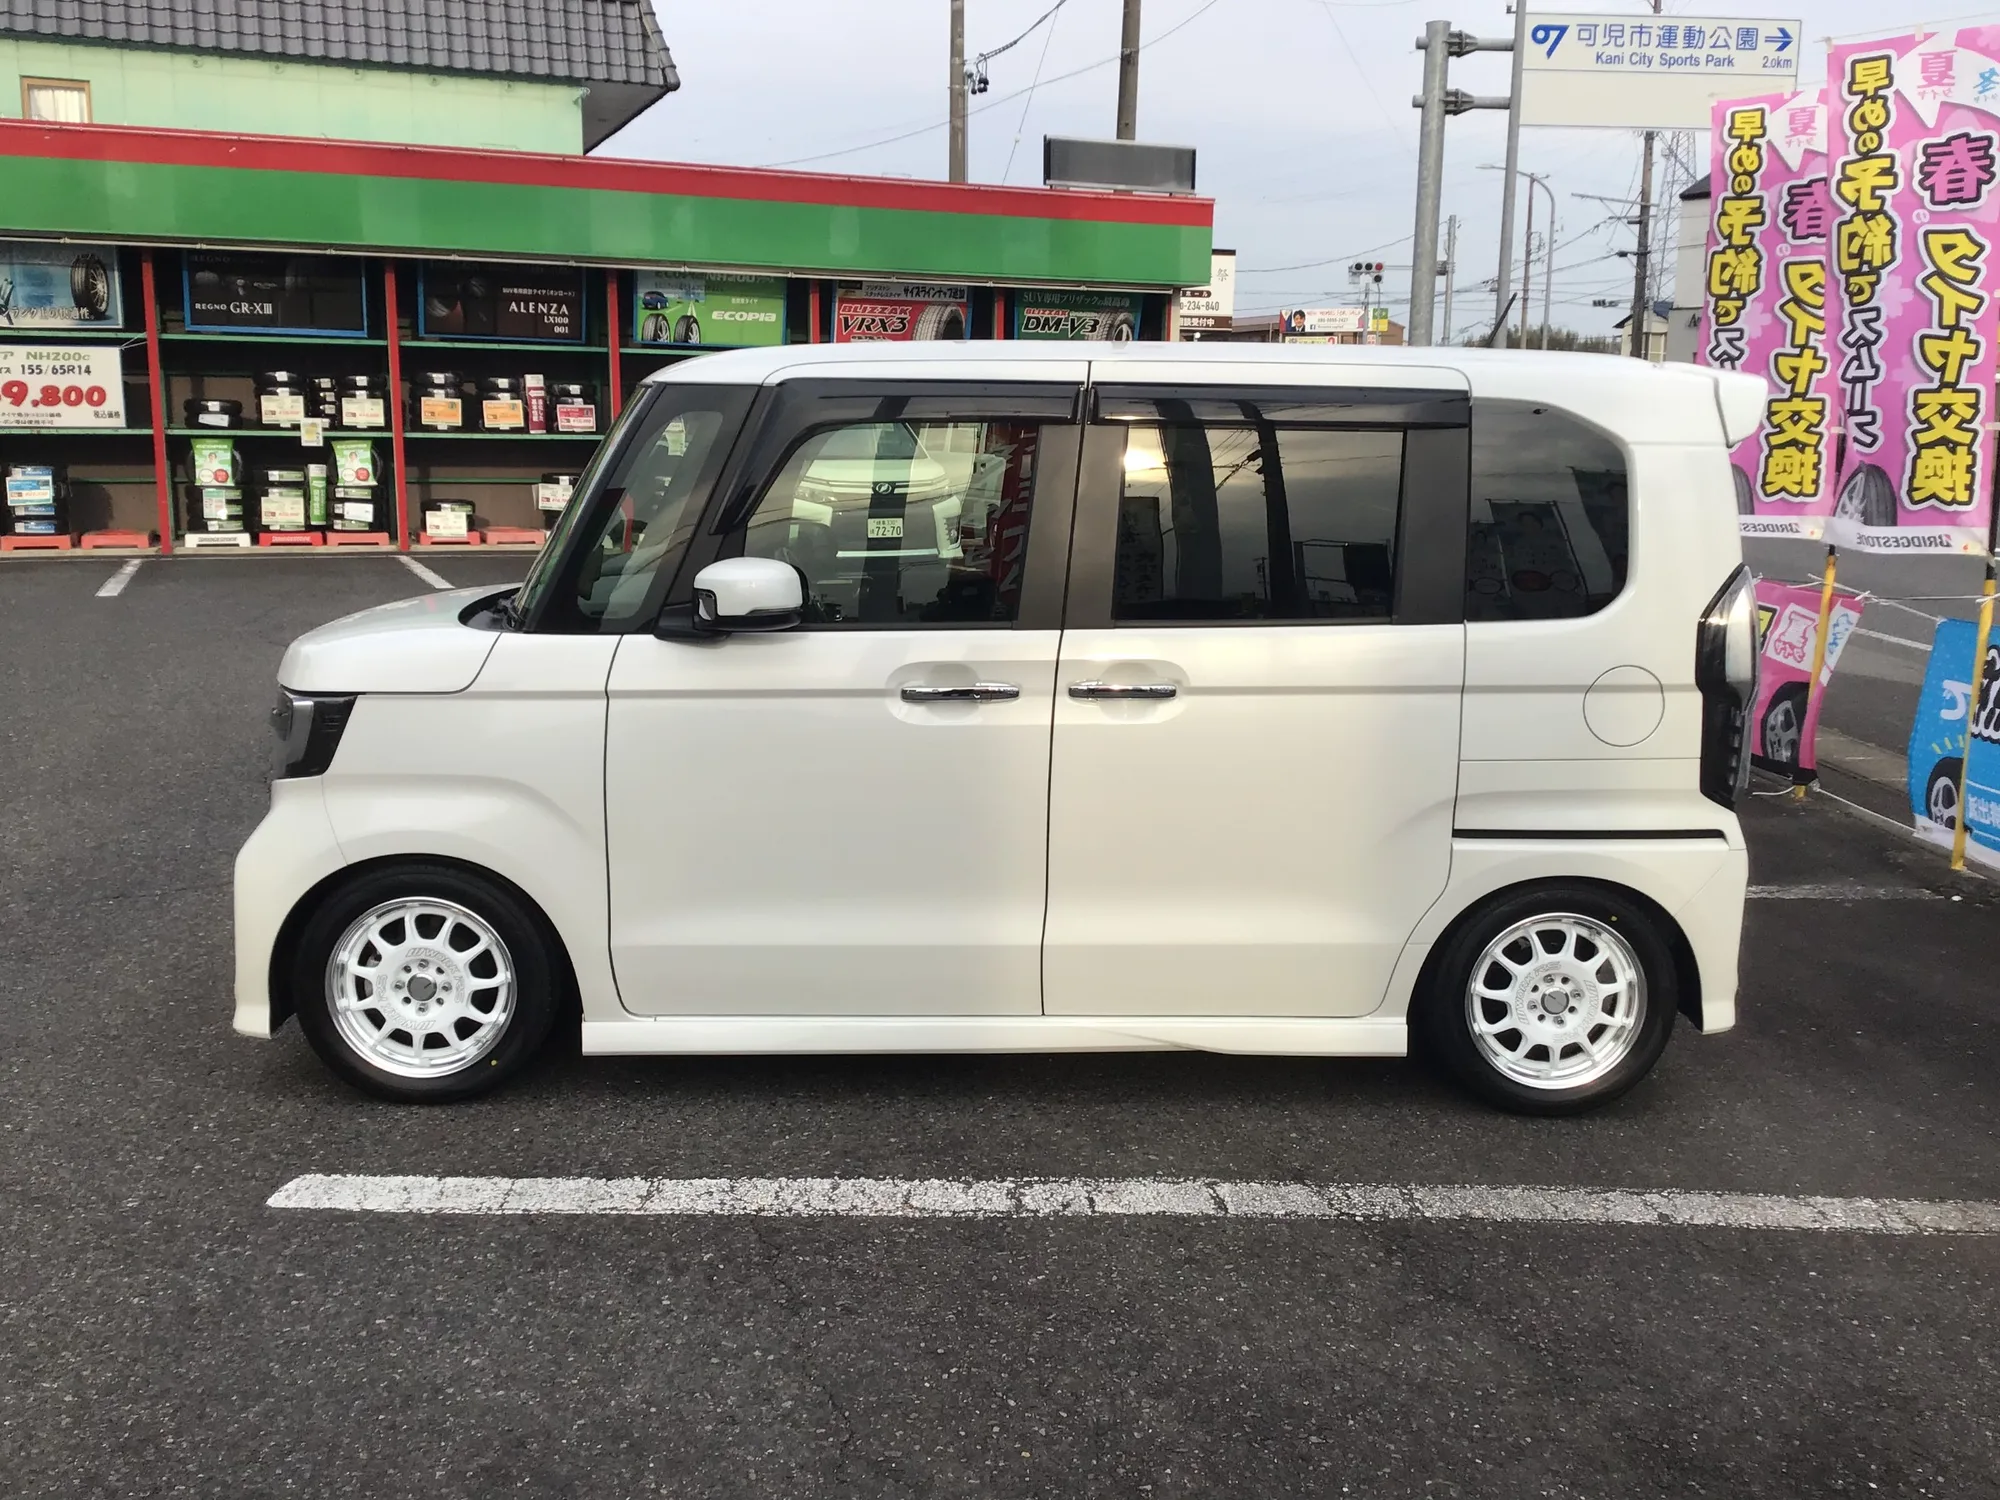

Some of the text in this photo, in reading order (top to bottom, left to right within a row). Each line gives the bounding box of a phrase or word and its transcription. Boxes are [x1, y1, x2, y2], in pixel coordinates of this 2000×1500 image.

[1576, 22, 1759, 51] 可児市運動公園
[1595, 52, 1735, 69] Kani City Sports Park
[1216, 267, 1229, 282] 祭
[195, 302, 228, 311] REGNO
[508, 301, 570, 315] ALENZA
[840, 304, 912, 316] BLIZZAK
[1024, 307, 1070, 317] BLIZZAK
[543, 315, 569, 324] LX100
[711, 310, 777, 322] ECOPIA
[554, 325, 569, 334] 001
[840, 314, 911, 335] VRX3
[1021, 315, 1101, 338] DM-V3
[20, 364, 92, 376] 155/65R14
[0, 380, 107, 408] 9,800
[93, 410, 121, 420] 税込価格
